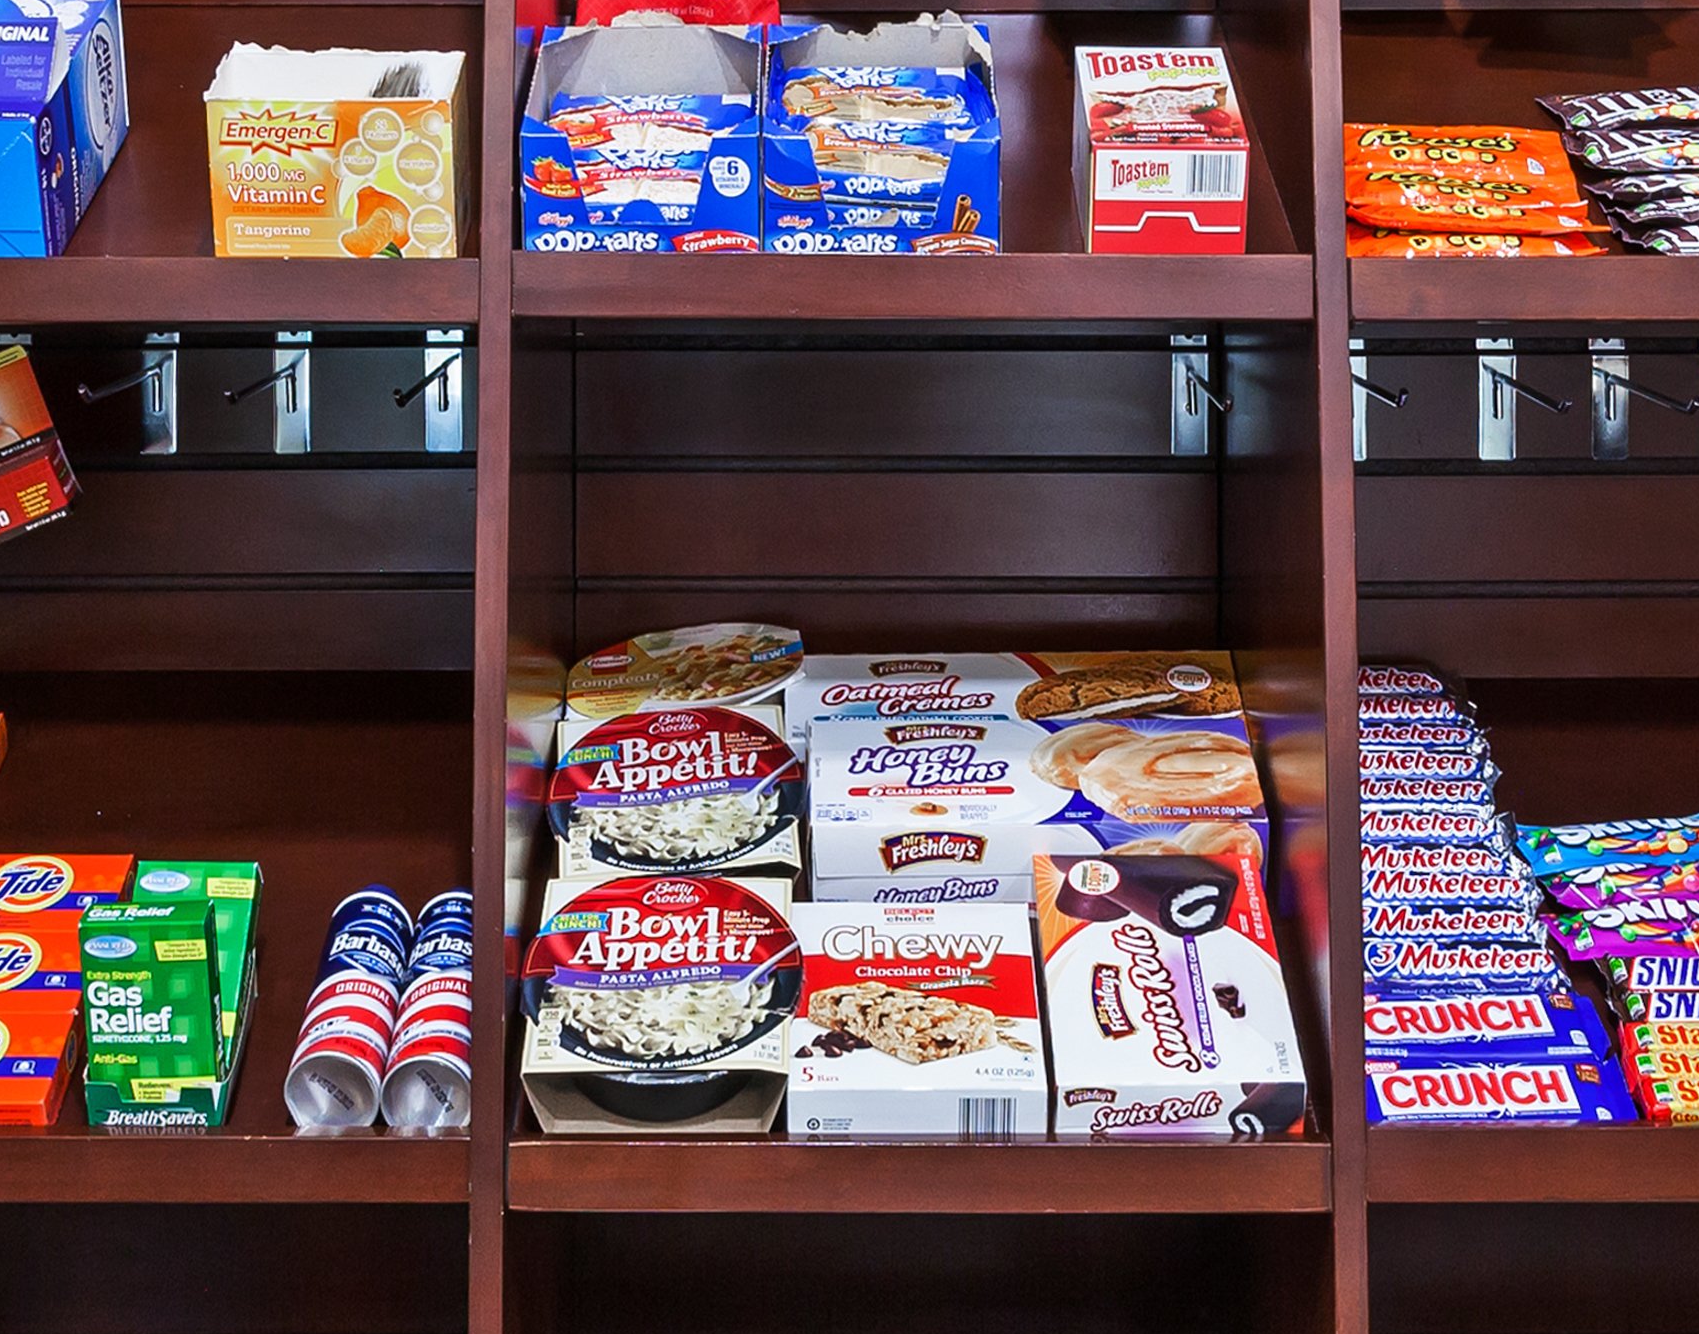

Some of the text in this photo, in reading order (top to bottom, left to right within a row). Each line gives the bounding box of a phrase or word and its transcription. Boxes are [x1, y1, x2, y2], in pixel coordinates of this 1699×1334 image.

[225, 119, 333, 146] Emergen-C
[226, 163, 305, 184] 1,000 MG
[227, 184, 326, 206] Vitamin C
[234, 222, 310, 238] Tangerine
[752, 647, 787, 663] NEW!
[571, 672, 662, 689] Compleats
[850, 745, 975, 774] Honey
[908, 762, 1009, 788] Buns
[891, 837, 980, 864] Freshley's
[642, 892, 701, 905] Crocker
[653, 881, 695, 897] Betty
[605, 906, 721, 941] Bowl
[822, 926, 1002, 968] Chewy
[87, 970, 151, 981] Extra Strength
[600, 965, 722, 985] PASTA ALFREDO
[855, 966, 972, 979] Chocolate Chip
[86, 982, 143, 1007] Gas
[335, 979, 390, 1005] ORIGINAL
[920, 979, 985, 991] Granola Bars
[91, 1007, 172, 1033] Relief
[93, 1053, 138, 1064] Anti-Gas
[801, 1066, 839, 1083] 5 Bars
[974, 1067, 1035, 1079] 4.4 OZ (125g)
[1382, 1066, 1566, 1108] CRUNCH
[1091, 1092, 1222, 1132] Swiss Rolls
